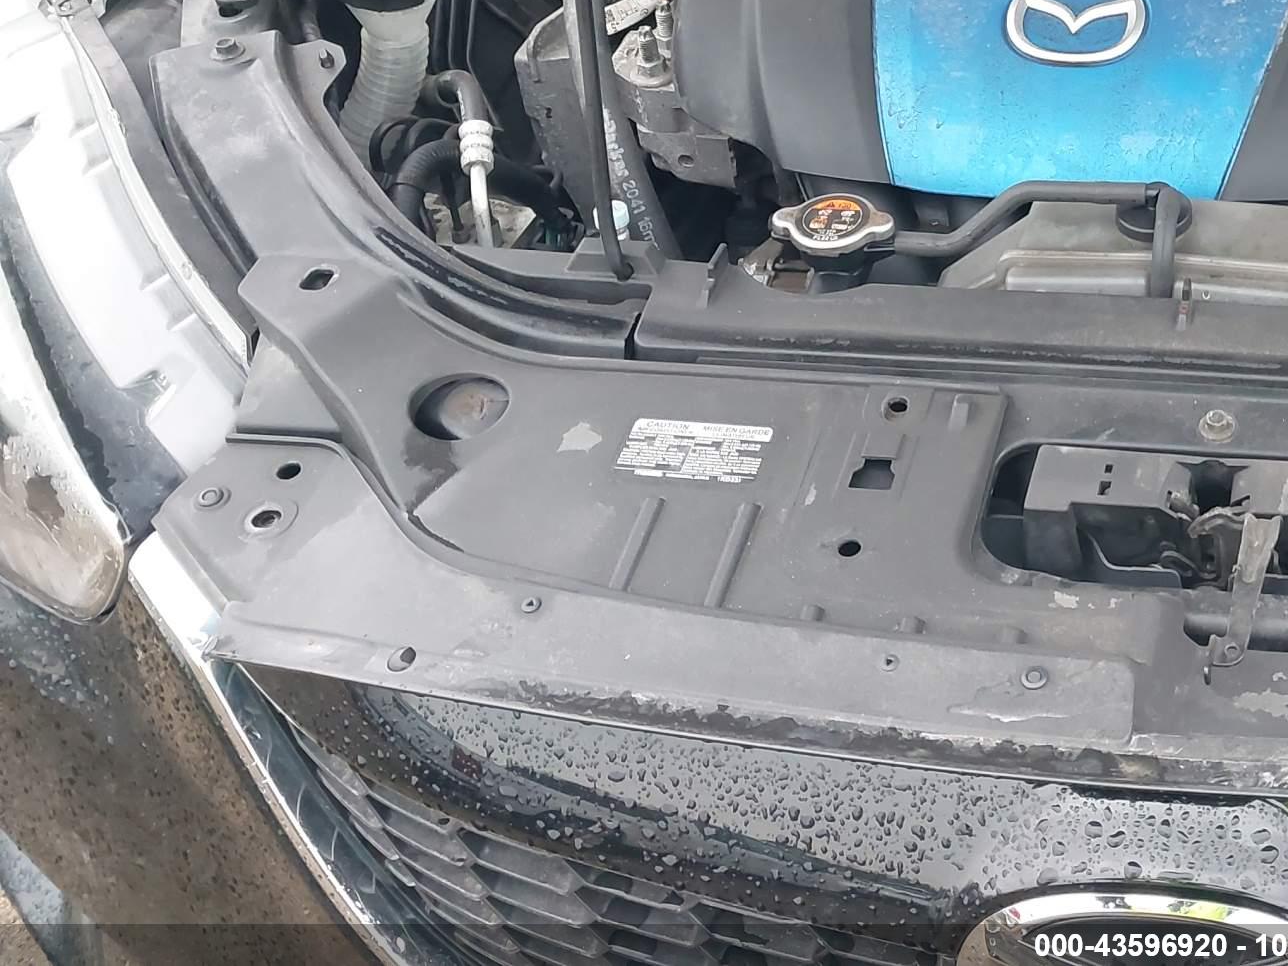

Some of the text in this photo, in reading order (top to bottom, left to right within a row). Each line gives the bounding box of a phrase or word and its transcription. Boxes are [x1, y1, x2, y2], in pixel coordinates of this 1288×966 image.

[622, 179, 646, 214] 2041
[646, 420, 690, 430] CAUTION
[738, 428, 771, 436] GARDE
